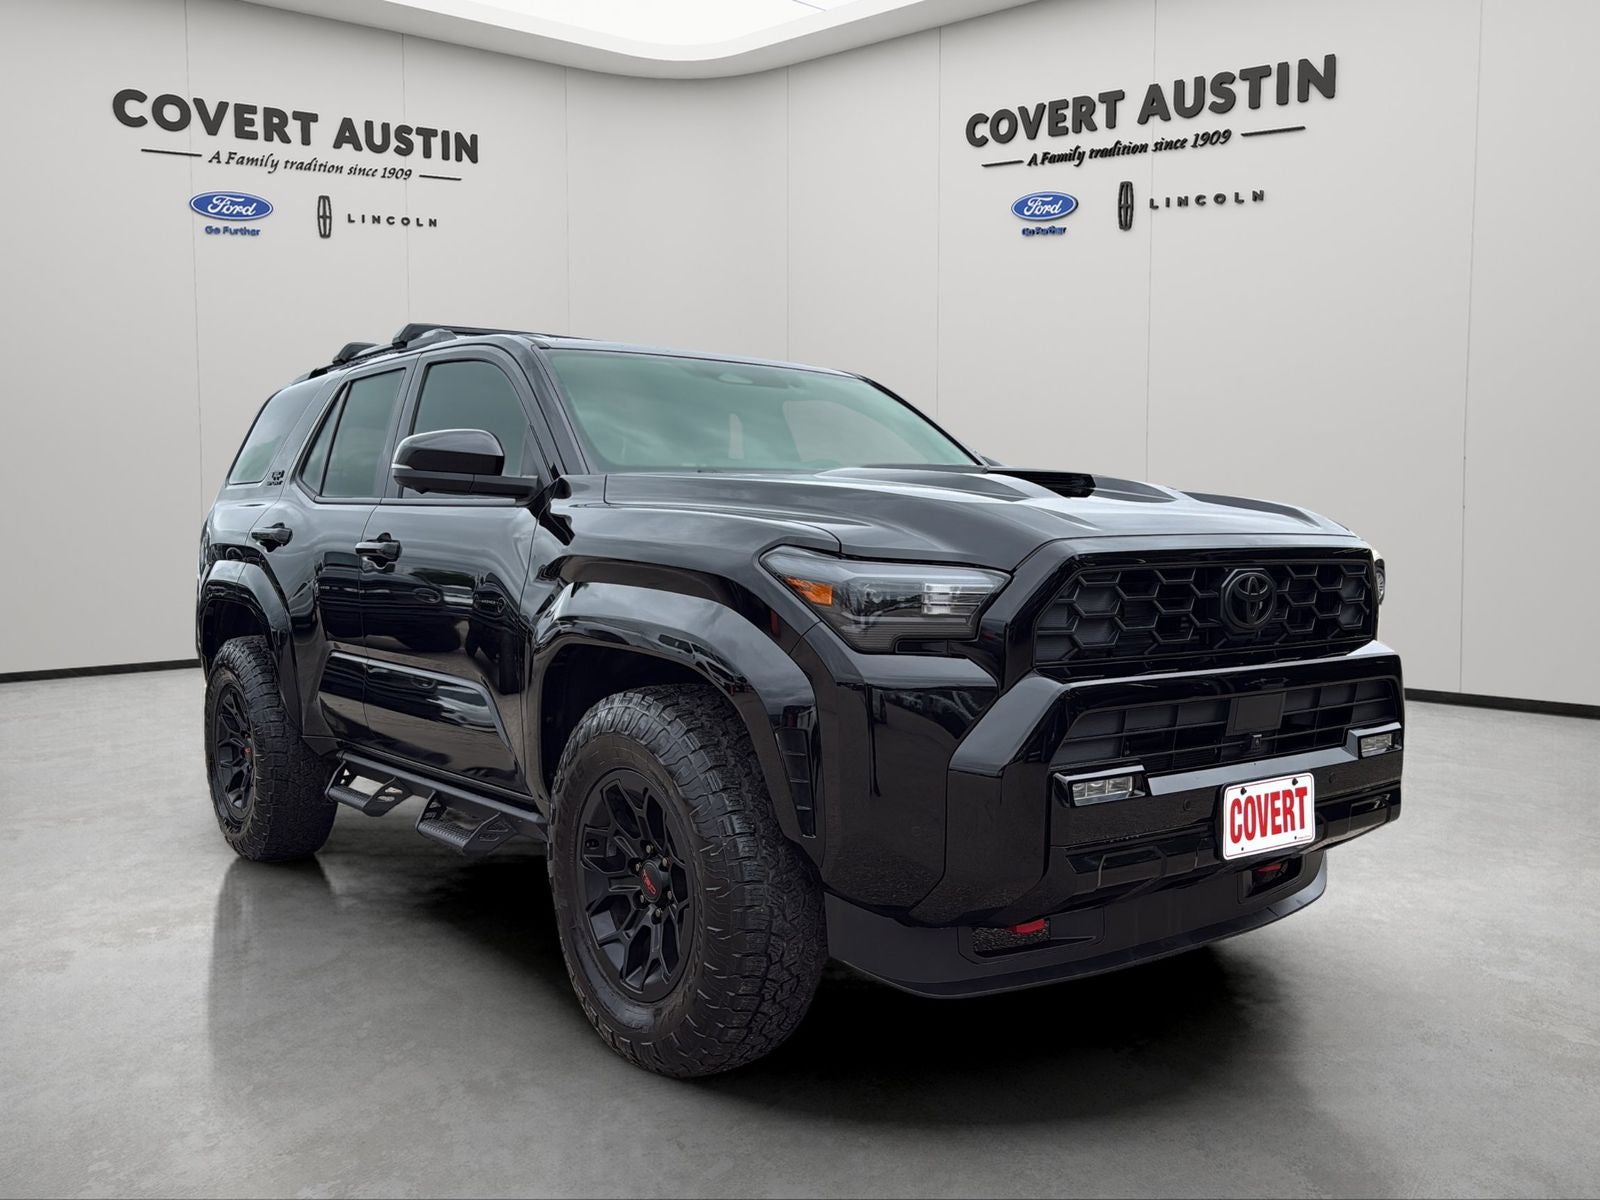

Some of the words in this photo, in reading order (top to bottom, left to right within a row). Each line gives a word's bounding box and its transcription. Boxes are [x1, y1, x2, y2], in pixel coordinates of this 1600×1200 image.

[966, 89, 1125, 148] COVERT
[1137, 54, 1336, 125] AUSTIN
[112, 89, 318, 146] COVERT
[333, 117, 478, 164] AUSTIN
[1027, 153, 1040, 167] A
[1040, 146, 1086, 167] Family
[1088, 141, 1148, 159] tradition
[1152, 138, 1188, 152] since
[1191, 129, 1232, 148] 1909
[208, 151, 221, 164] A
[225, 152, 279, 174] Family
[284, 159, 343, 174] tradition
[348, 164, 378, 177] since
[381, 167, 412, 180] 1909
[207, 195, 257, 216] Ford
[1023, 196, 1063, 215] Ford
[1150, 190, 1264, 210] LINCOLN
[205, 226, 220, 235] Go
[223, 226, 260, 236] Further
[348, 214, 437, 227] LINCOLN
[1230, 786, 1308, 843] COVERT
